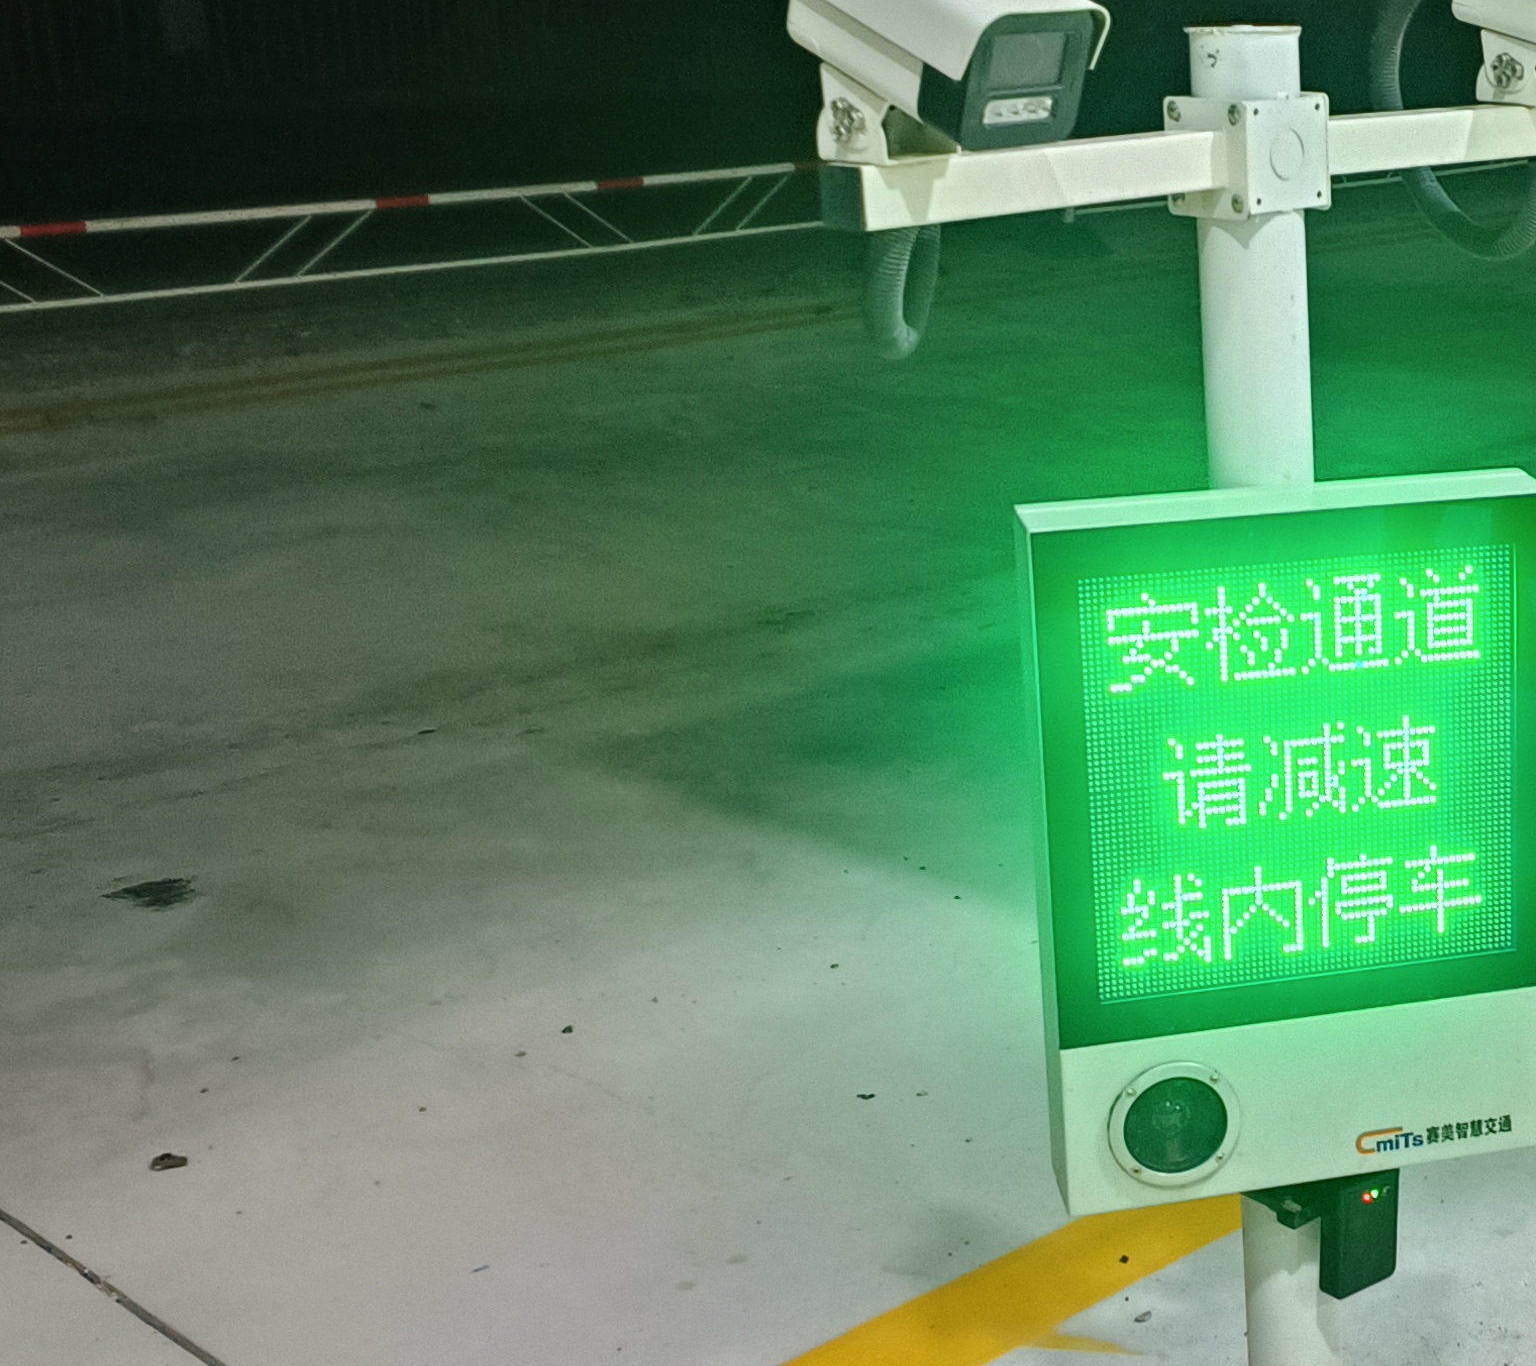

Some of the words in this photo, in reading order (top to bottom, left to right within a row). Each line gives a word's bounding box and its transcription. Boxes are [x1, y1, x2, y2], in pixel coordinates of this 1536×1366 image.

[1105, 565, 1482, 693] 安检通道
[1162, 715, 1438, 828] 请减速
[1120, 844, 1483, 966] 线内停车
[1426, 1114, 1513, 1145] 赛美智慧交通
